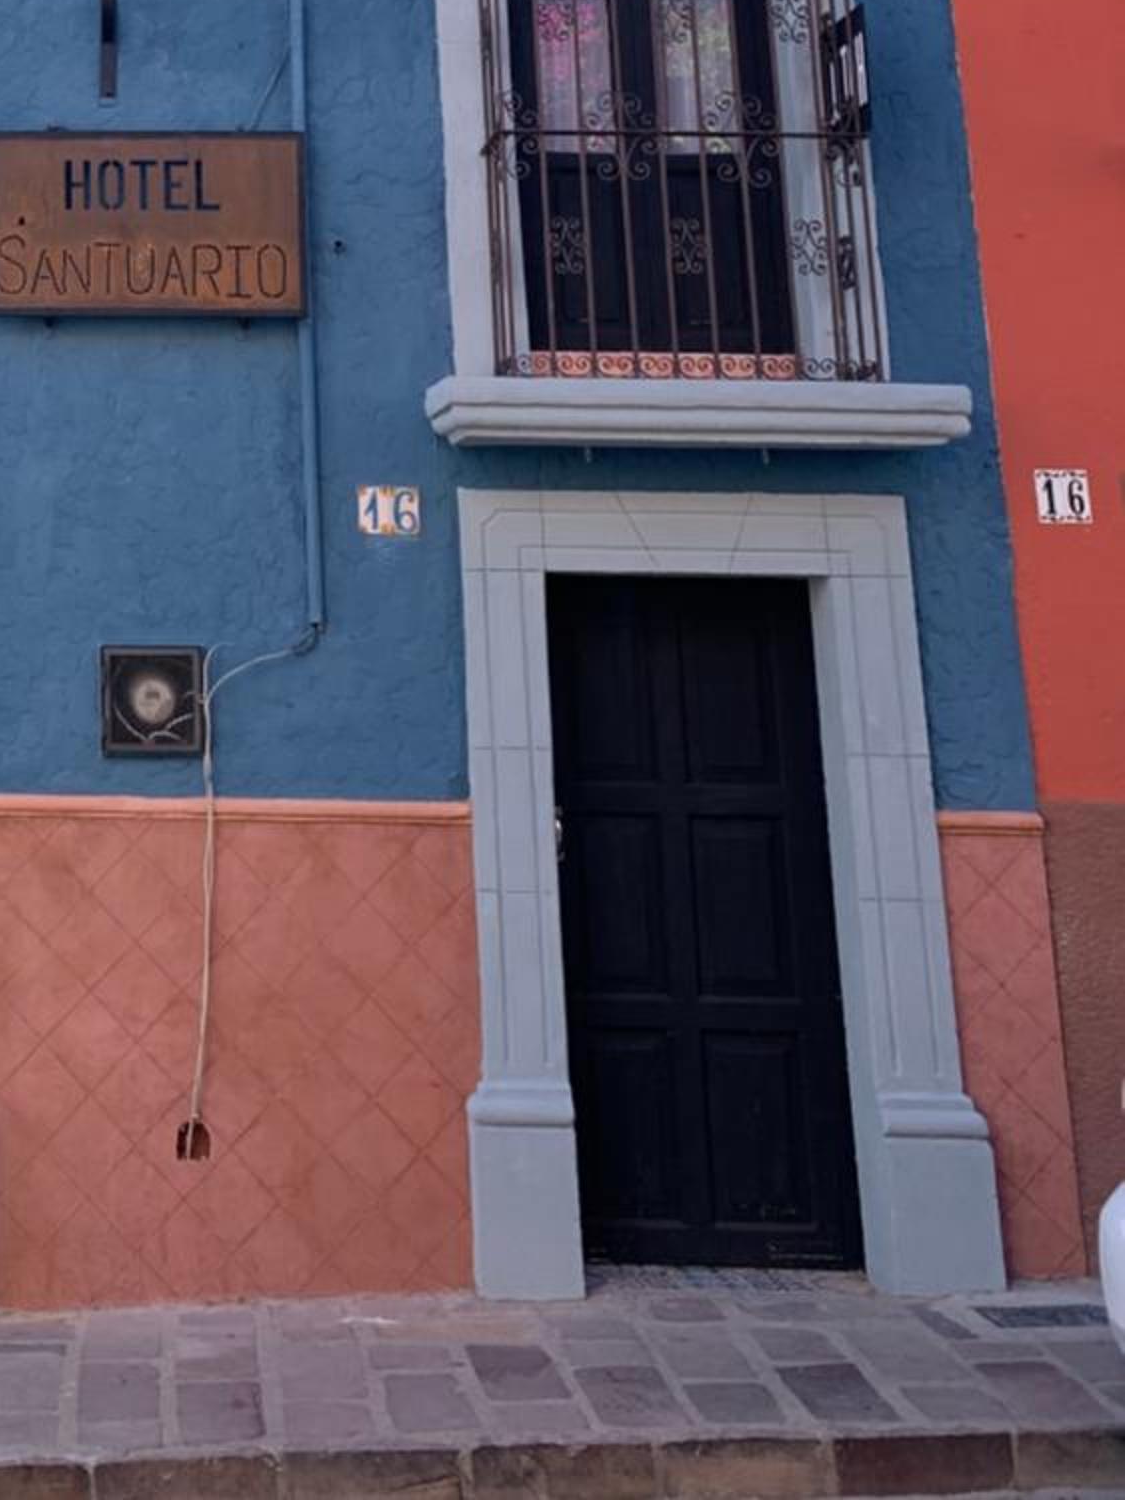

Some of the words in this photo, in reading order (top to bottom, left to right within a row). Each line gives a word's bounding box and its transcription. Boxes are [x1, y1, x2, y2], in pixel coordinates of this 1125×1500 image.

[63, 160, 220, 211] HOTEL
[363, 489, 418, 532] 16
[1042, 478, 1086, 516] 16
